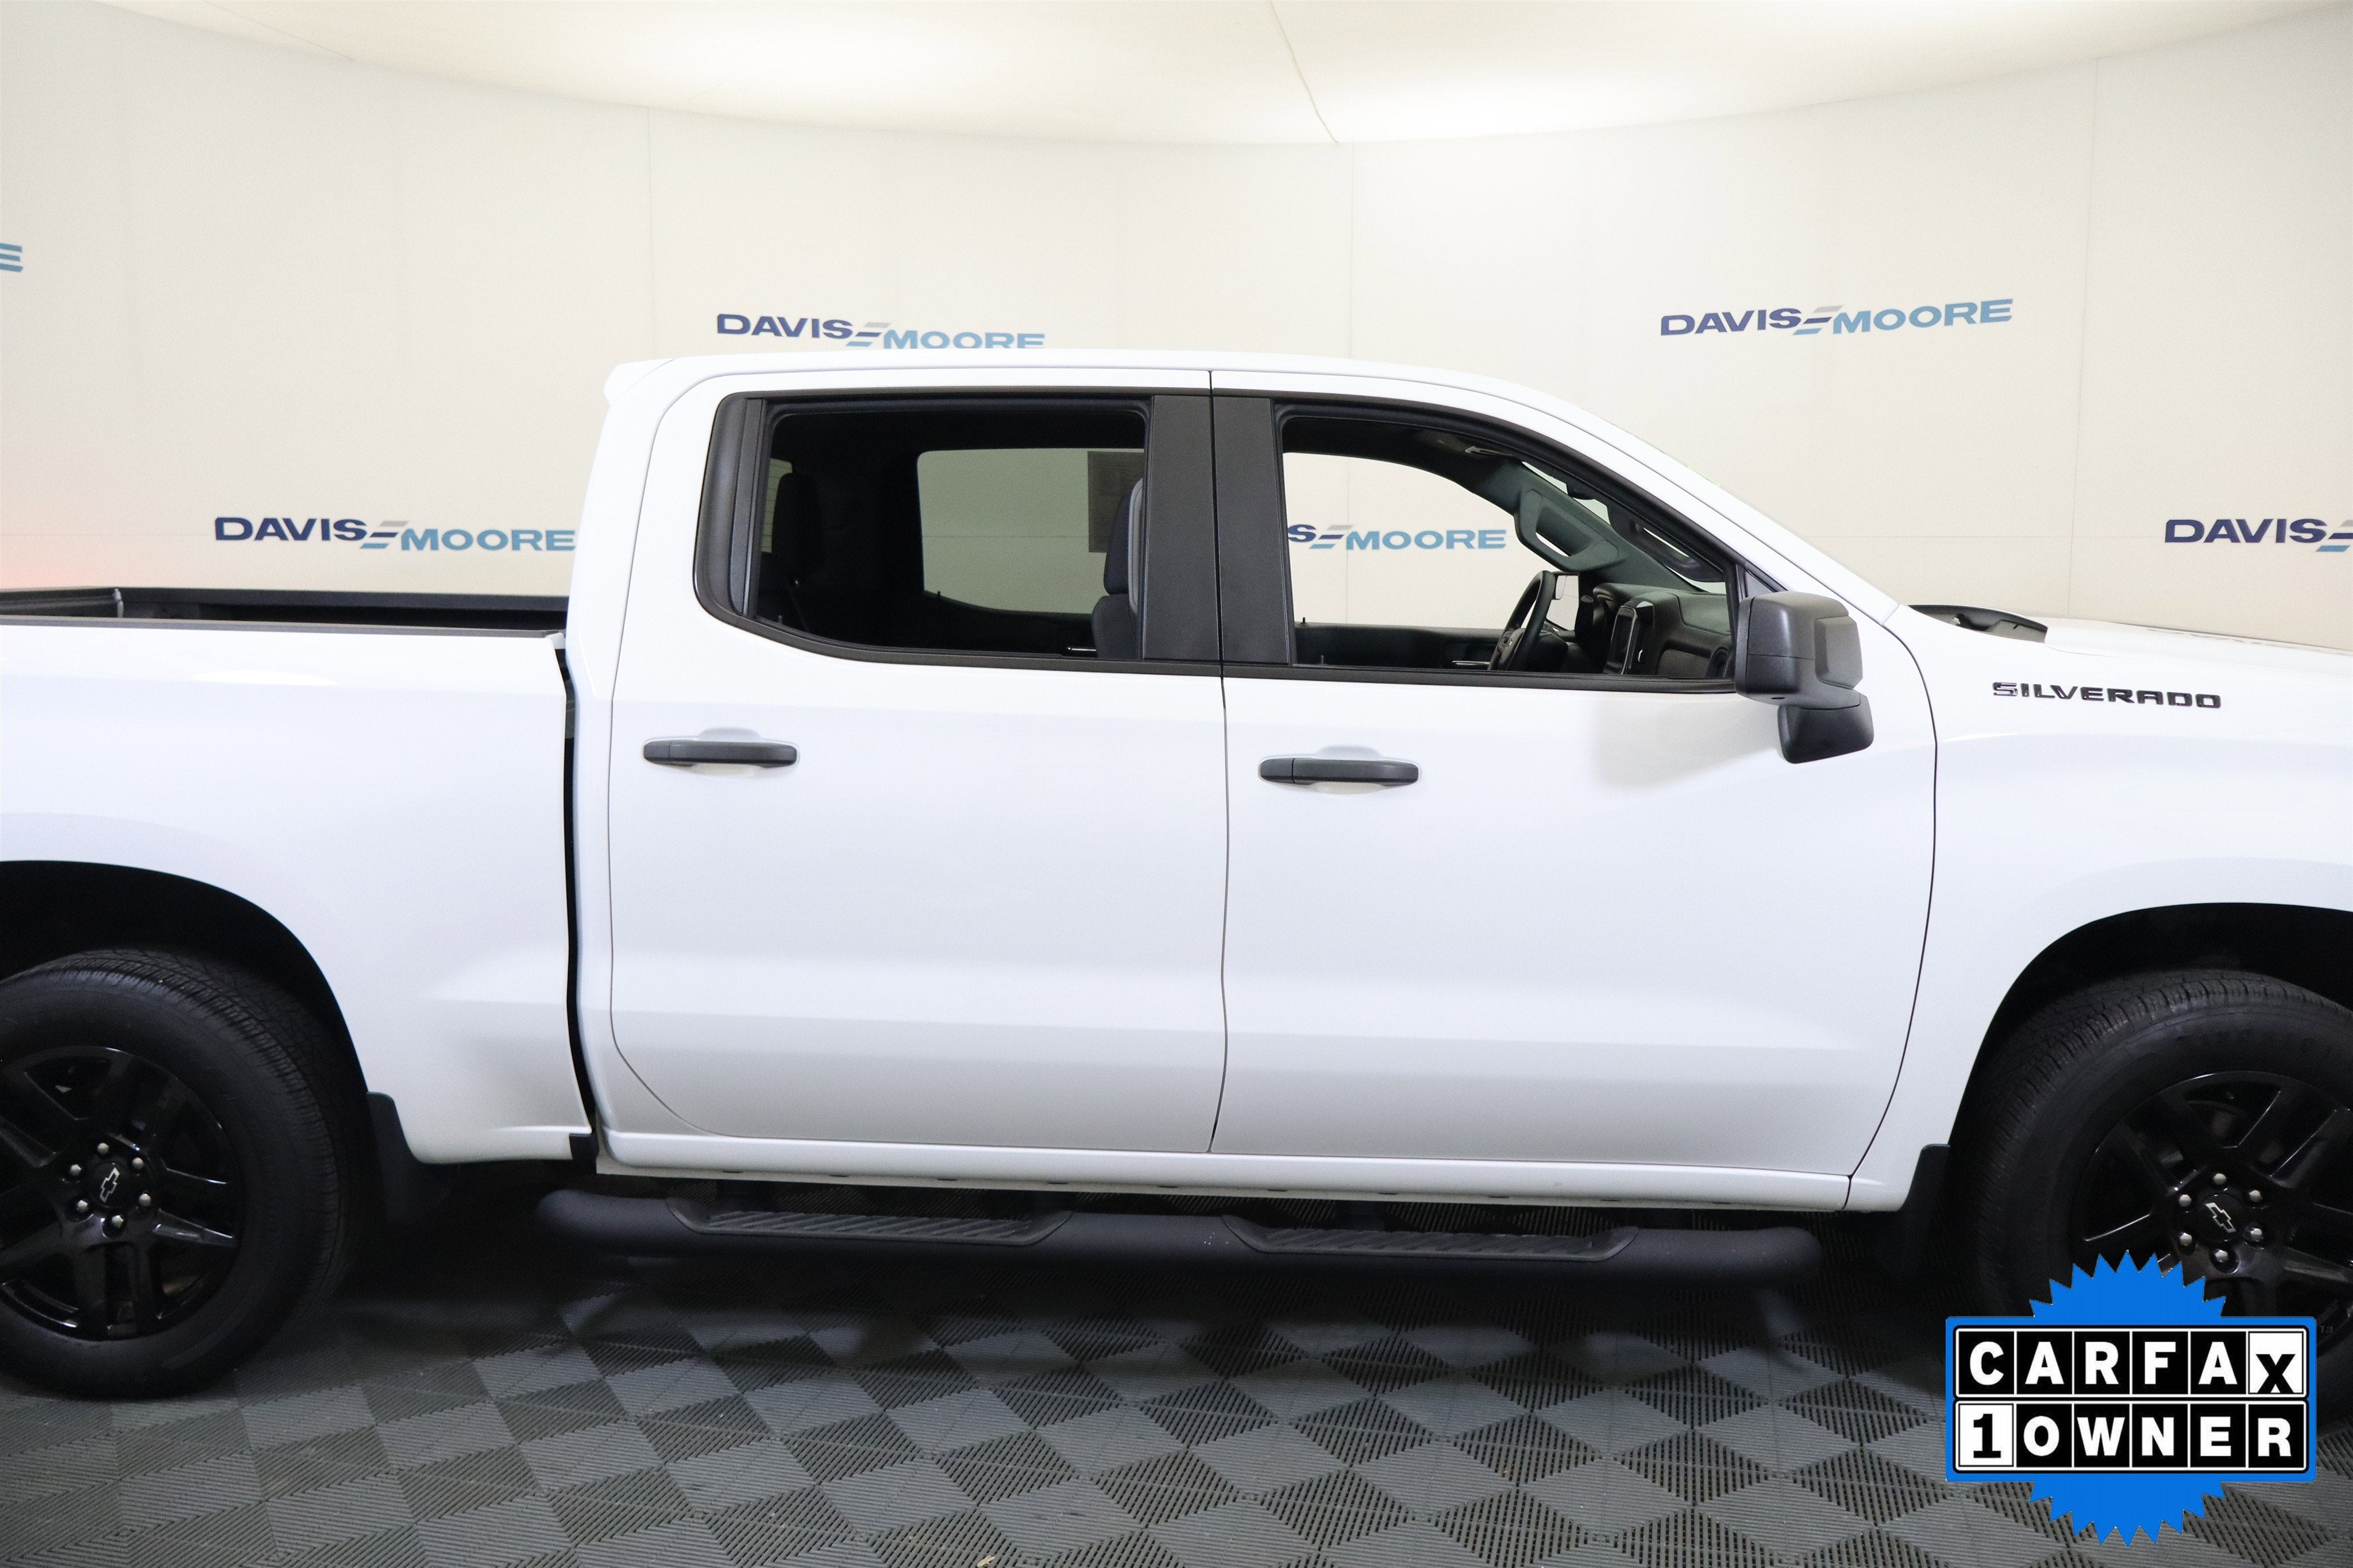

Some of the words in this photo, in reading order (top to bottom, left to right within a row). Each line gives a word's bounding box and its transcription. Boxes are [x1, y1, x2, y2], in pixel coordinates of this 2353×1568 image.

[717, 314, 854, 339] DAVIS
[884, 329, 1046, 349] MOORE
[1661, 308, 1802, 335] DAVIS
[1833, 299, 2013, 334] MOORE
[214, 517, 368, 542] DAVIS
[401, 529, 576, 551] MOORE
[1346, 530, 1507, 550] MOORE
[2165, 519, 2327, 543] DAVIS
[1992, 682, 2221, 709] SILVERADO
